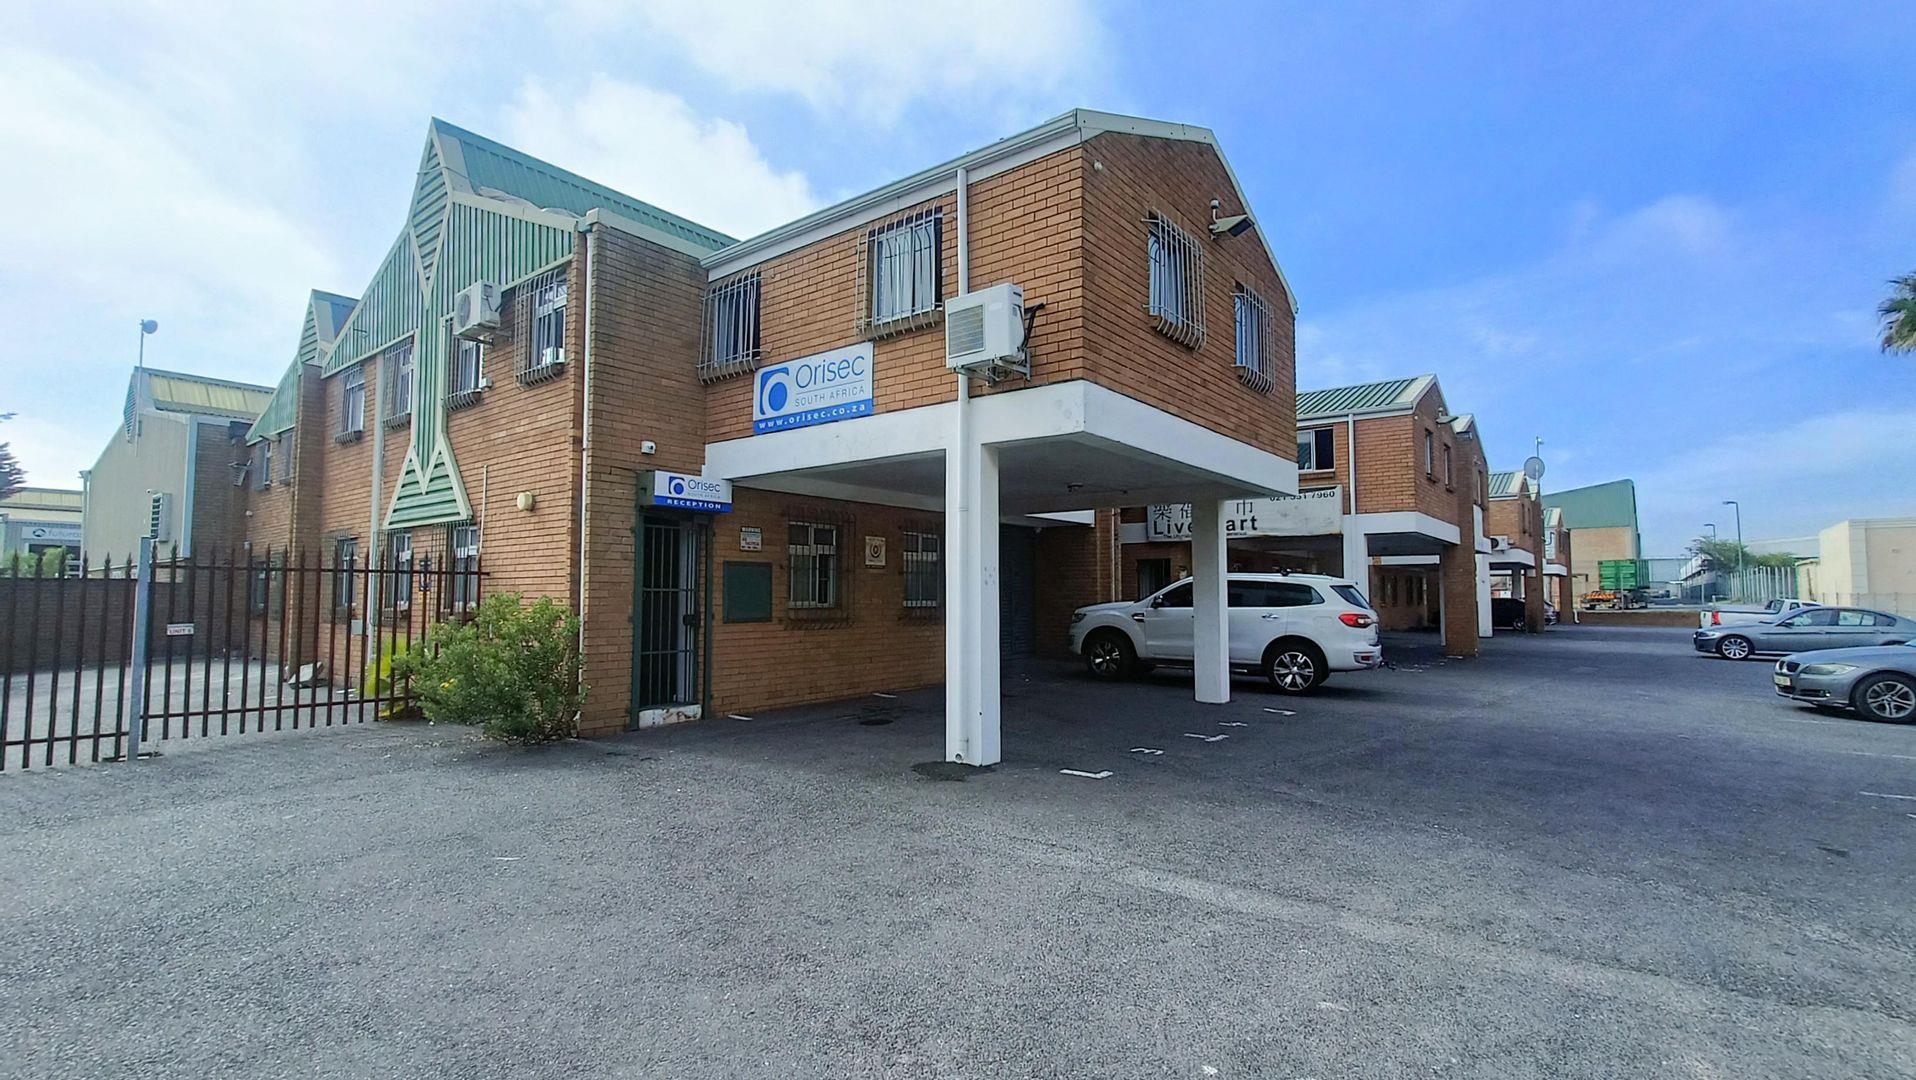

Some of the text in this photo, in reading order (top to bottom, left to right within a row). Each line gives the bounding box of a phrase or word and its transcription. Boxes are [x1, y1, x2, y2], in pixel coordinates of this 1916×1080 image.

[796, 355, 865, 389] Orisec
[794, 385, 865, 408] SOUTH AFRICA
[758, 403, 866, 430] www.orisec.co.za
[687, 479, 721, 493] Orisec
[667, 499, 721, 509] RECEPTION
